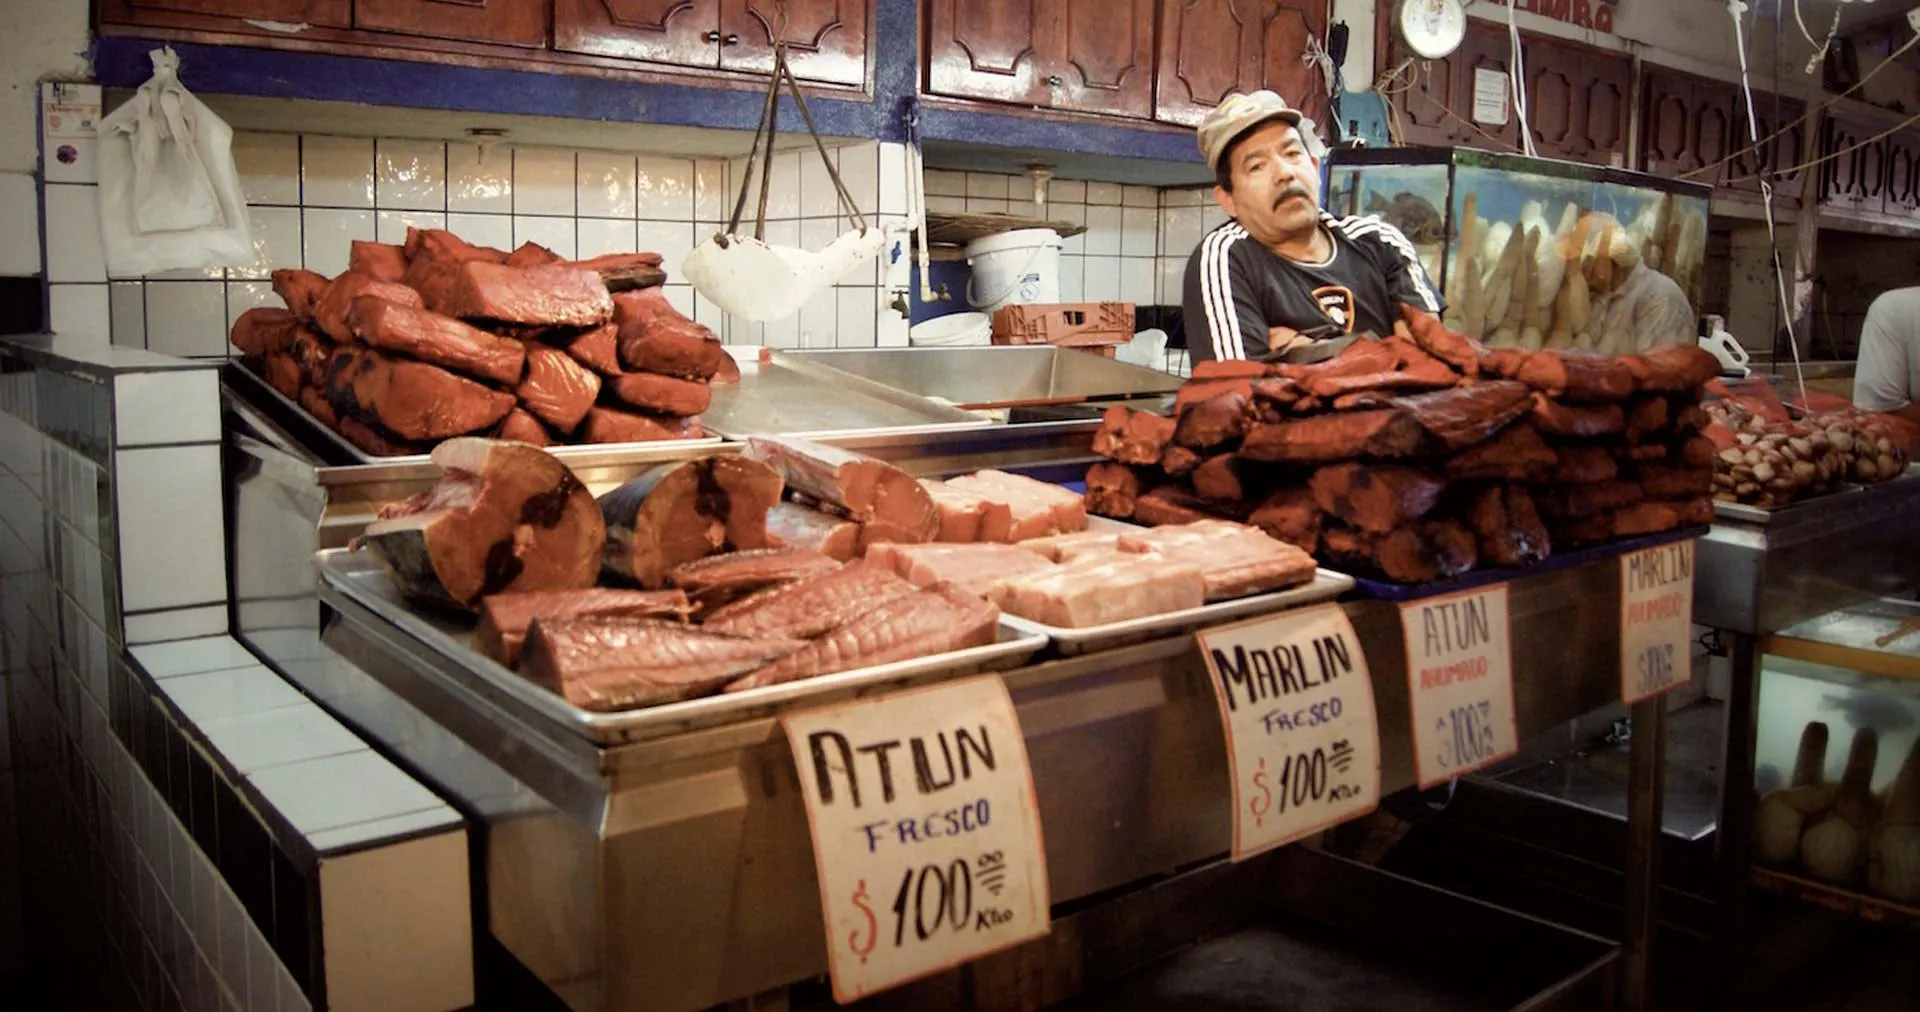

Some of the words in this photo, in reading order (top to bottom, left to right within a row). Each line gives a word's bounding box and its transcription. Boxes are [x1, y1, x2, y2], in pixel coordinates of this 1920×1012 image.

[1629, 543, 1690, 593] MARLIN
[1422, 596, 1489, 657] ATUN
[1210, 632, 1352, 712] MARLIN
[1420, 655, 1488, 692] AHUMADO
[1258, 697, 1343, 736] FRESCO
[808, 725, 996, 809] ATUN
[855, 798, 990, 853] FRESCO
